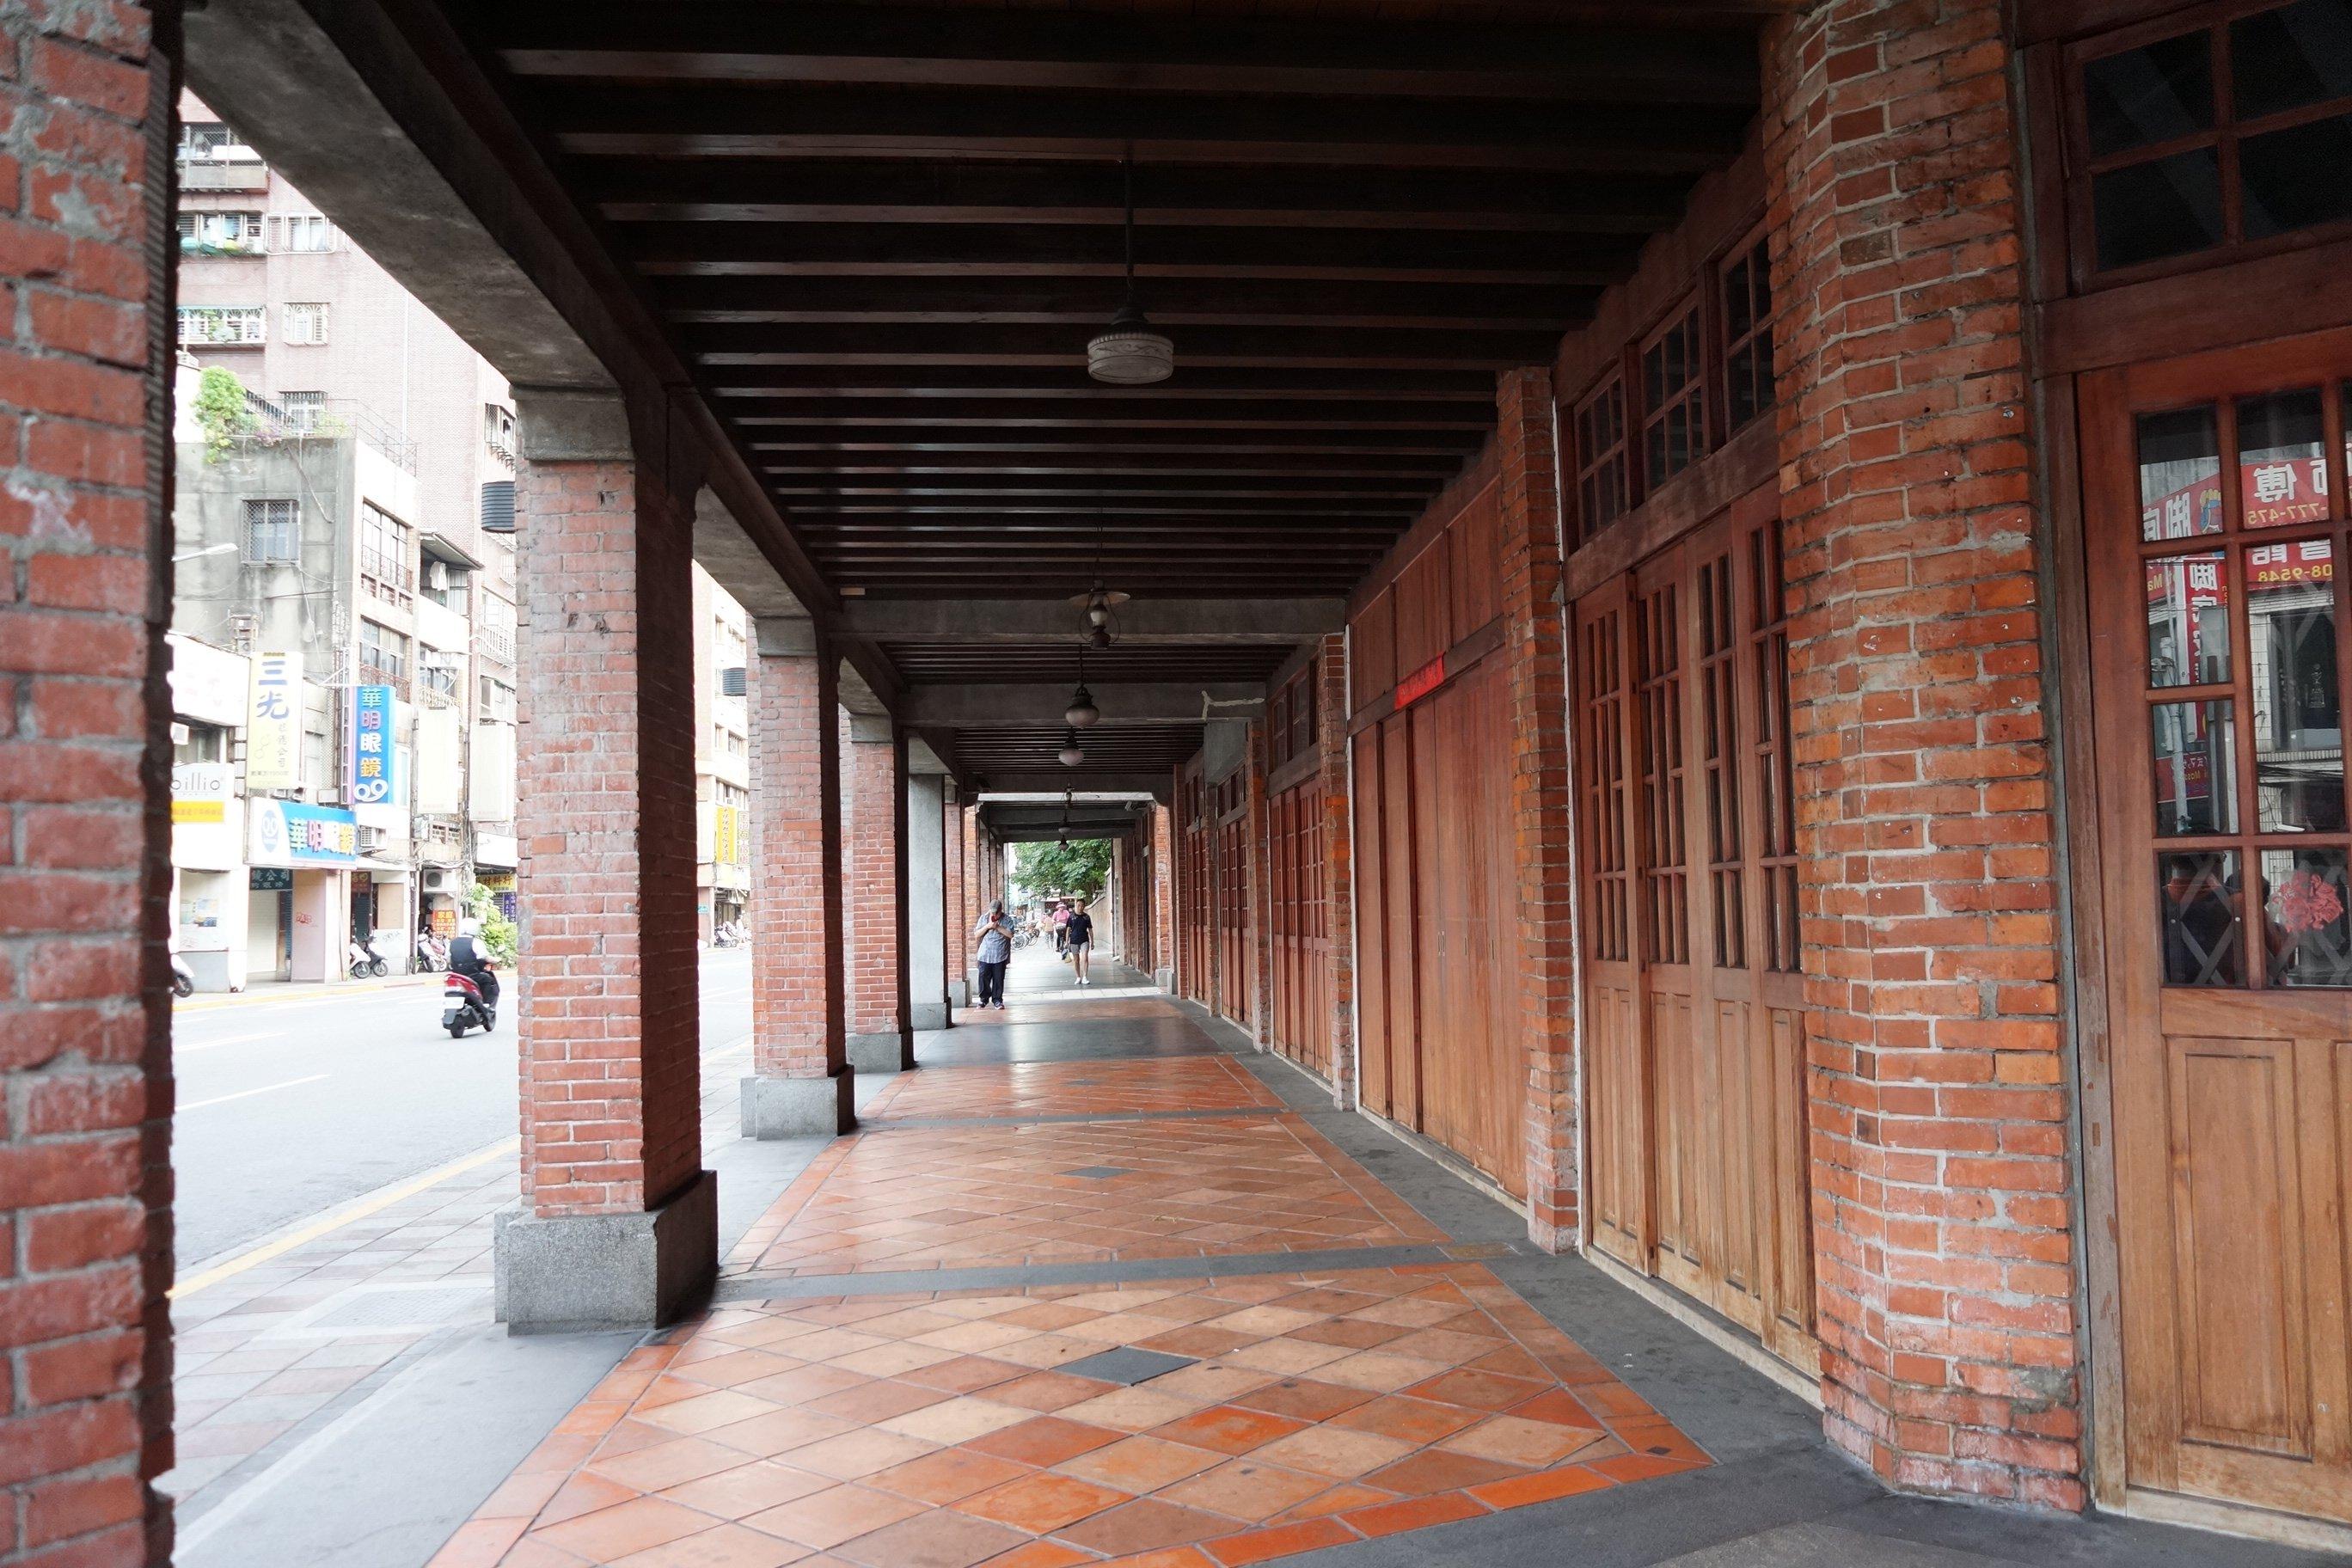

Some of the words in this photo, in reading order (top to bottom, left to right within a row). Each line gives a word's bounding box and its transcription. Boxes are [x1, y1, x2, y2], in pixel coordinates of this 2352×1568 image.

[256, 660, 291, 720] 三光
[360, 687, 383, 778] 華明眼鏡
[288, 816, 356, 855] 華明眼鏡
